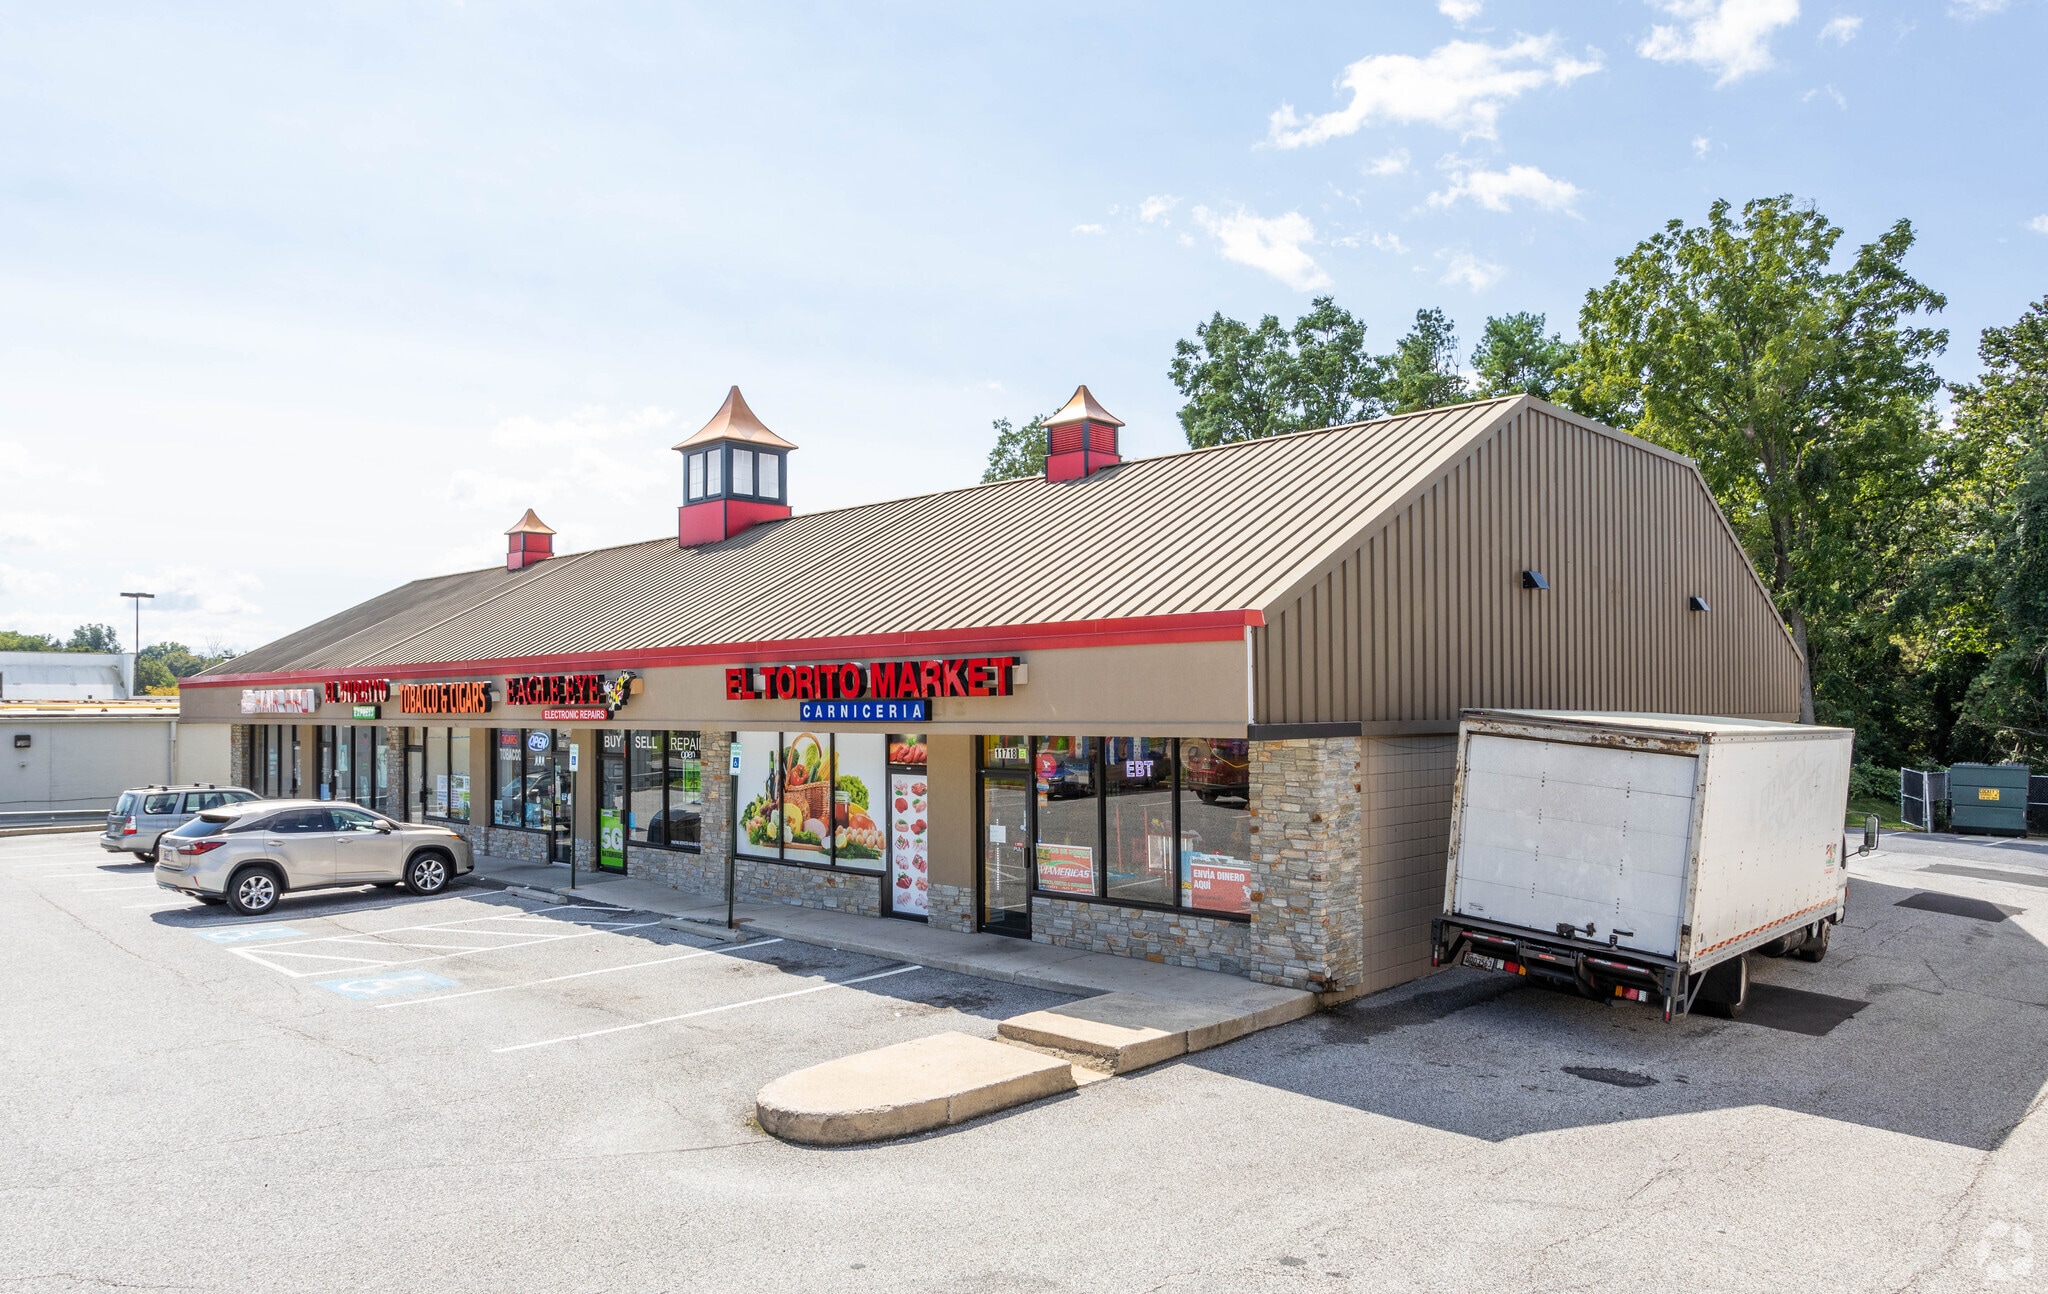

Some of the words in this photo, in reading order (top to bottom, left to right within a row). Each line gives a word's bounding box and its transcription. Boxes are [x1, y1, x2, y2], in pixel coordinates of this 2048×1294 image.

[726, 667, 755, 700] EL
[760, 662, 865, 699] TORITO
[870, 656, 1015, 698] MARKET
[325, 681, 338, 703] EL
[340, 679, 388, 703] BURRITO
[505, 675, 559, 705] EAGLE
[564, 674, 601, 704] EYE
[398, 683, 438, 714] TOBACCO
[441, 683, 448, 714] &
[449, 681, 486, 714] CIGARS
[353, 706, 376, 718] EXPRESS
[544, 709, 579, 719] ELECTRONIC
[580, 709, 605, 719] REPAIRS
[802, 703, 922, 719] CARNICERIA
[529, 734, 547, 749] OPEN
[604, 735, 621, 748] BUY
[635, 735, 657, 749] SELL
[670, 737, 700, 751] REPAI
[500, 748, 521, 761] TOBACCO
[680, 750, 696, 759] open
[996, 749, 1017, 758] 11718
[1126, 760, 1153, 778] EBT
[602, 827, 623, 850] 5G
[1040, 865, 1090, 879] VIAMERICAS
[1217, 871, 1245, 883] DINERO
